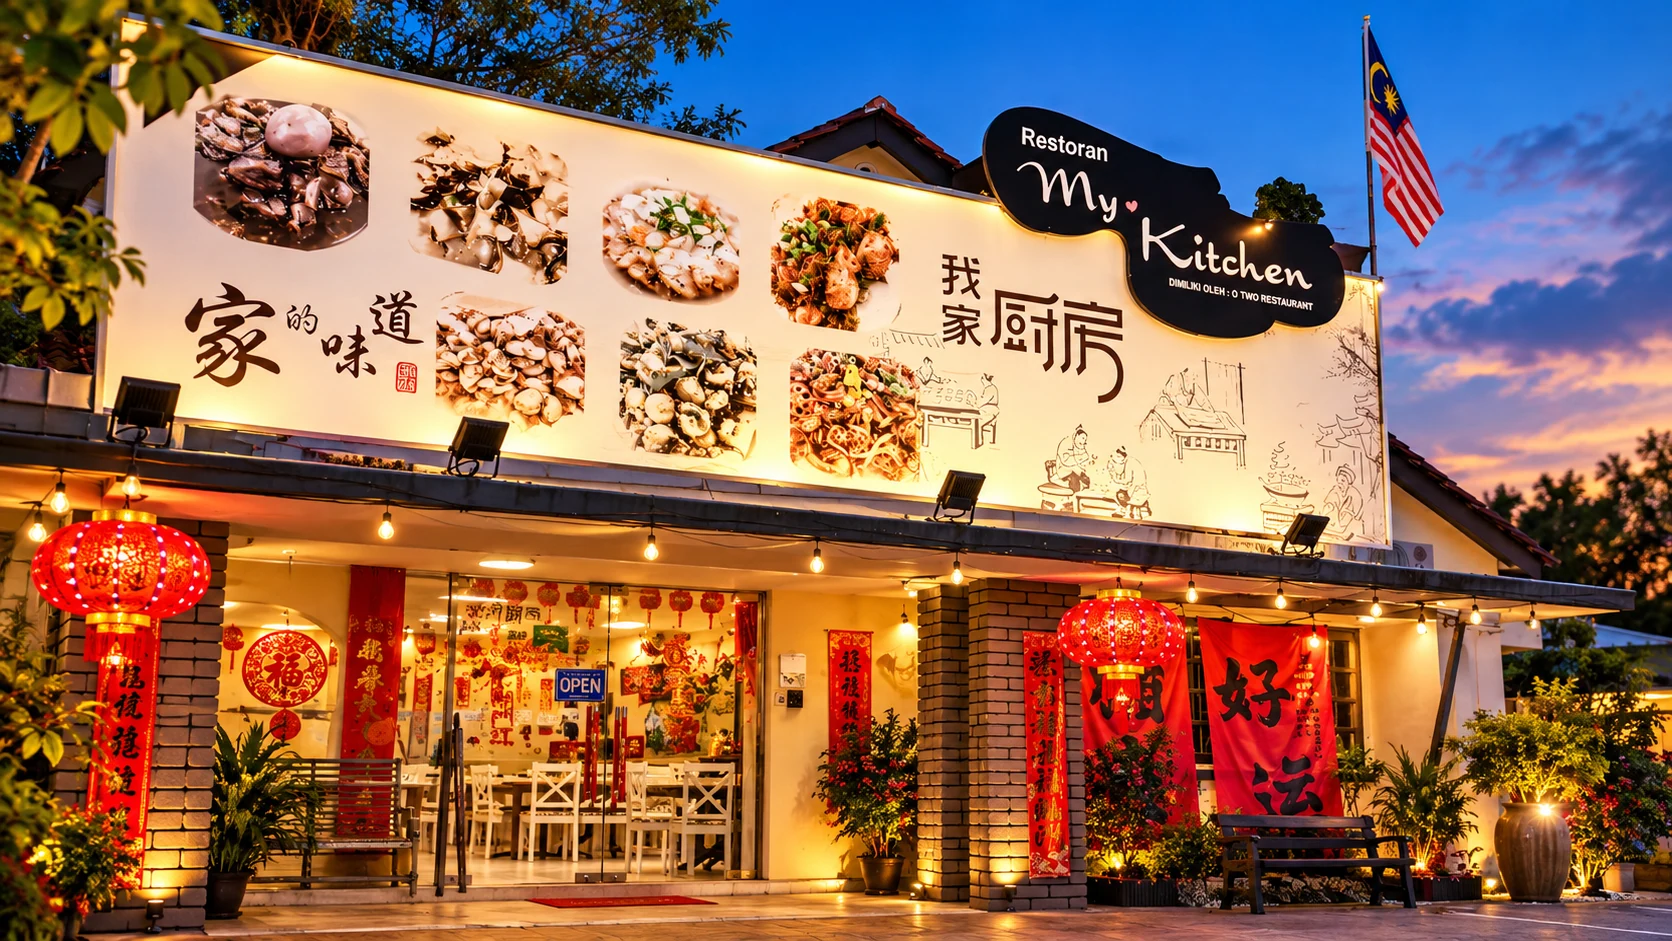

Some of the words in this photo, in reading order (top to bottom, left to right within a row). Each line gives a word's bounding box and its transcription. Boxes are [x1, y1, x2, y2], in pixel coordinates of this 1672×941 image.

[1021, 126, 1108, 162] Restoran
[1016, 161, 1118, 223] My
[1141, 216, 1313, 290] Kitchen
[1168, 277, 1202, 292] DIMILIKI
[1202, 283, 1226, 297] OLEH
[1239, 290, 1260, 302] TWO
[1260, 294, 1314, 311] RESTAURANT
[184, 282, 425, 388] 家的味道
[941, 253, 982, 347] 我家
[990, 289, 1124, 404] 厨房
[264, 652, 304, 688] 福
[560, 677, 601, 694] OPEN
